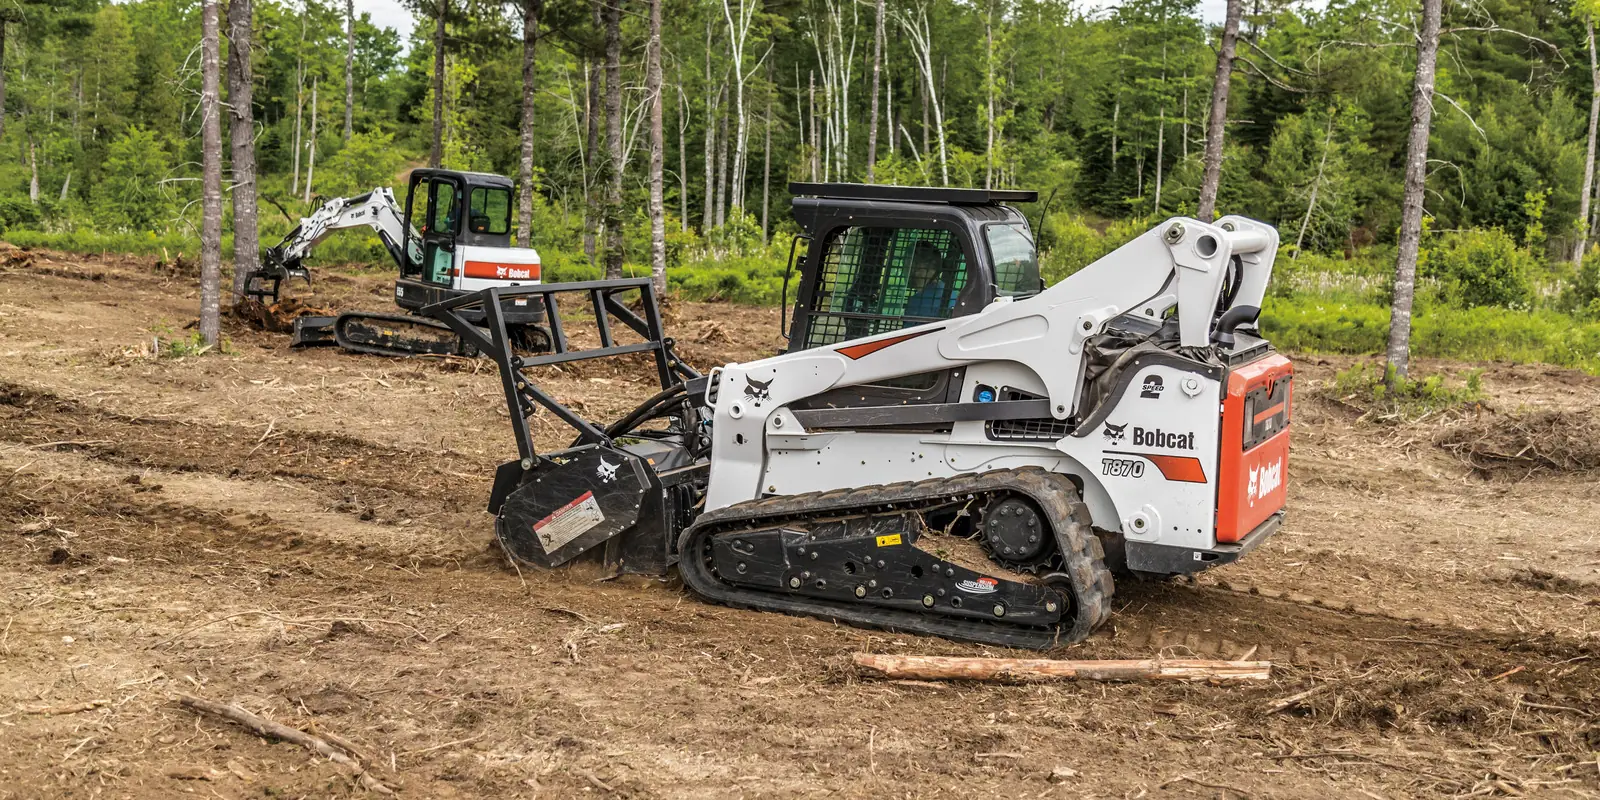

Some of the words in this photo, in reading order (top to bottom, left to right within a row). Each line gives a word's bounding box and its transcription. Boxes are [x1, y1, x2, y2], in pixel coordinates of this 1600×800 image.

[508, 268, 530, 279] Bobcat
[1140, 374, 1164, 399] 2
[1142, 384, 1165, 392] SPEED
[1133, 427, 1194, 450] Bobcat
[1102, 458, 1145, 478] T870
[1258, 456, 1282, 499] Bobcat
